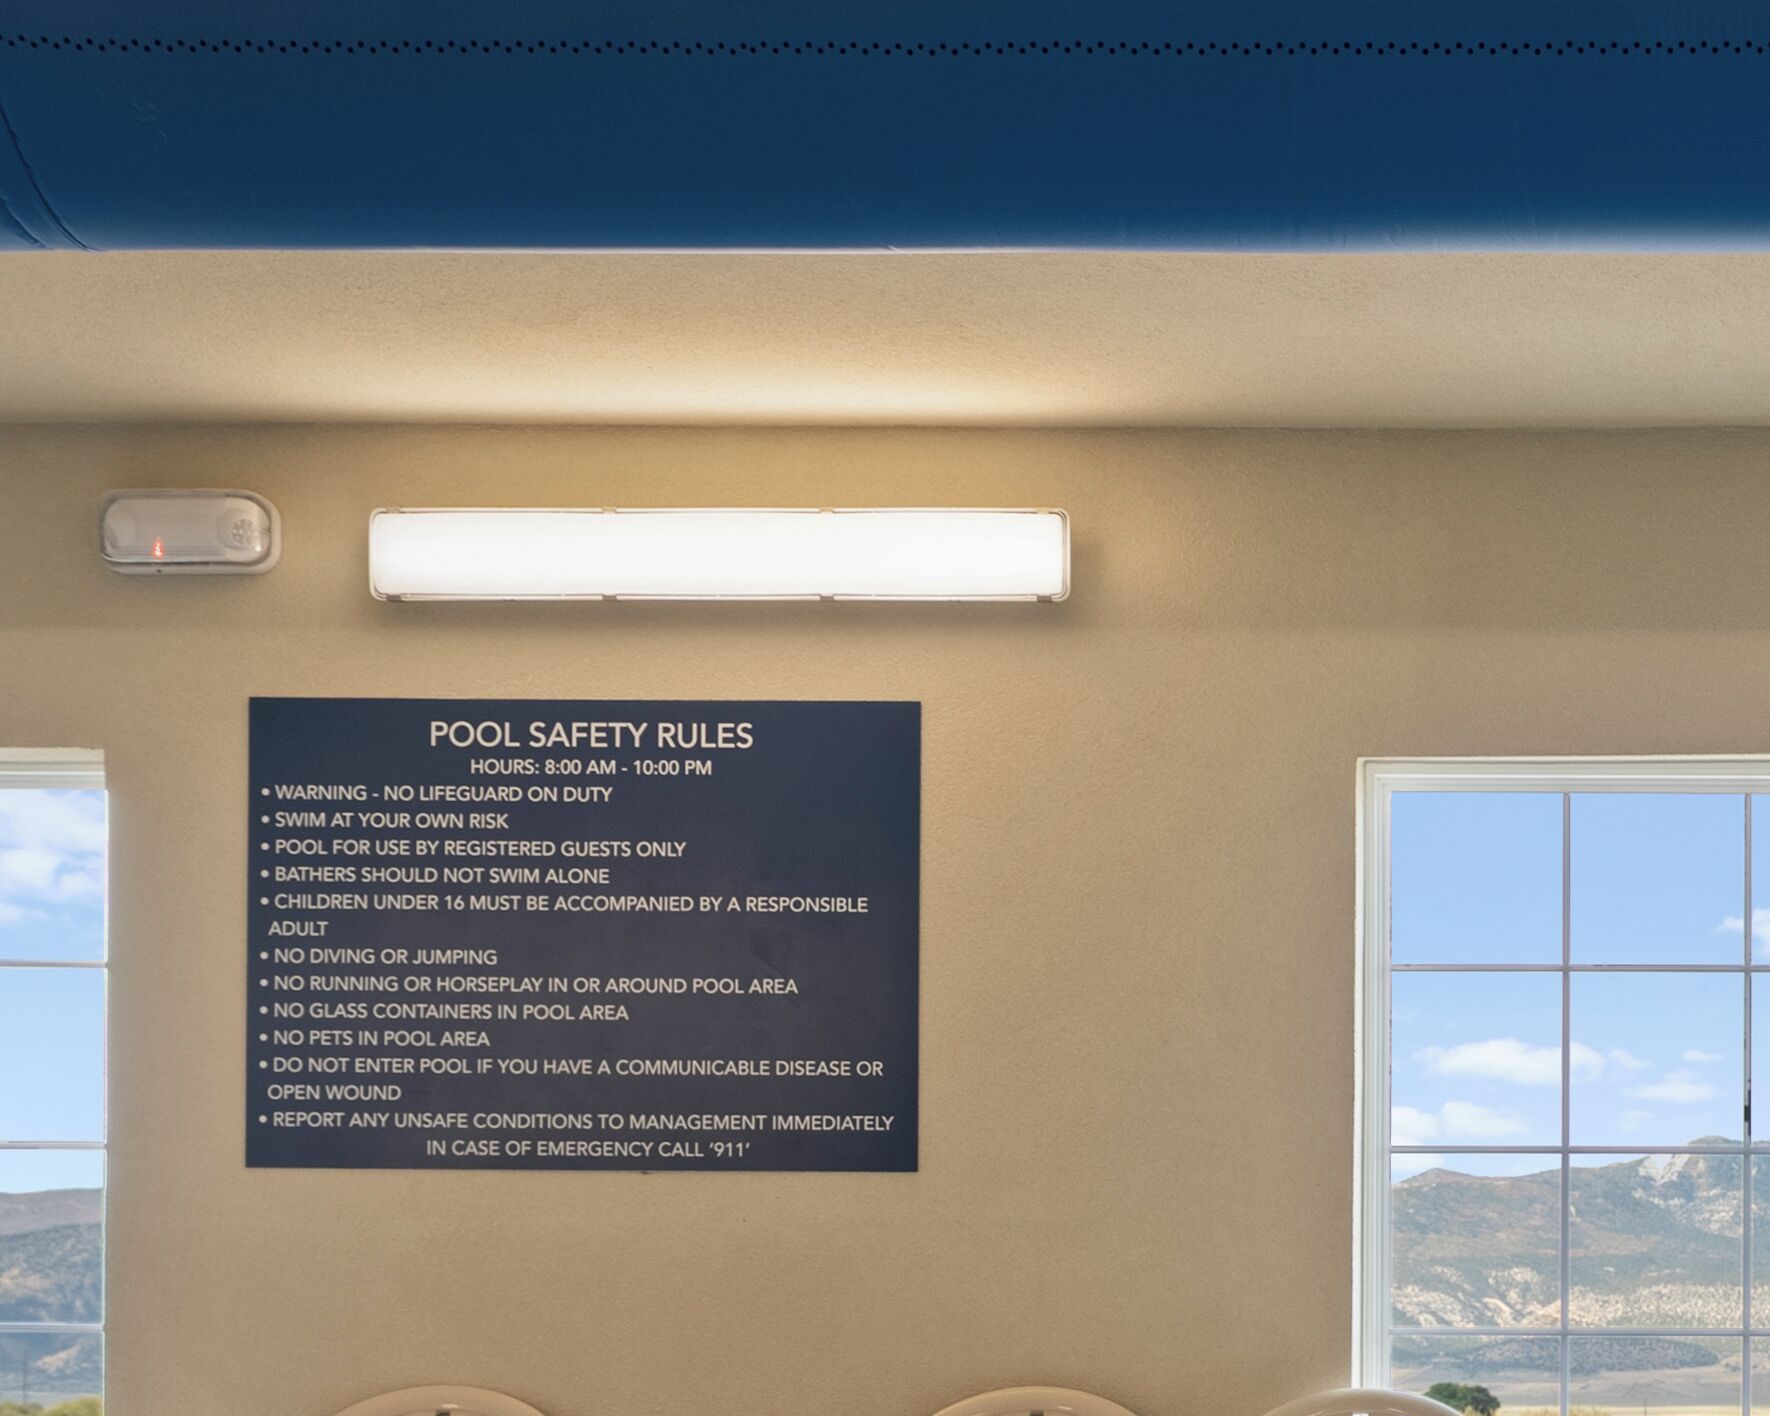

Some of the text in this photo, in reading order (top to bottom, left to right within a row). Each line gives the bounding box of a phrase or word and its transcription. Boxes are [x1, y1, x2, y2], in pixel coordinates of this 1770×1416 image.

[430, 720, 754, 749] POOL SAFETY RULES
[470, 758, 540, 775] HOURS:
[544, 758, 583, 775] 8:00
[585, 759, 617, 775] AM
[632, 759, 680, 776] 10:00
[684, 759, 713, 776] PM
[274, 784, 368, 801] WARNING
[383, 784, 415, 802] NO
[419, 785, 523, 802] LIFEGUARD
[527, 785, 558, 803] ON
[562, 786, 614, 803] DUTY
[274, 811, 510, 830] SWIM AT YOUR OWN RISK
[275, 838, 687, 858] POOL FOR USE BY REGISTERED GUESTS ONLY
[274, 865, 610, 884] BATHERS SHOULD NOT SWIM ALONE
[274, 893, 869, 913] CHILDREN UNDER 16 MUST BE ACCOMPANIED BY A RESPONSIBLE
[267, 920, 329, 937] ADULT
[274, 947, 498, 966] NO DIVING OR JUMPING
[274, 975, 799, 995] NO RUNNING OR HORSEPLAY IN OR AROUND POOL AREA
[273, 1002, 630, 1021] NO GLASS CONTAINERS IN POOL AREA
[273, 1029, 491, 1047] NO PETS IN POOL AREA
[273, 1056, 884, 1077] DO NOT ENTER POOL IF YOU HAVE A COMMUNICABLE DISEASE OR
[267, 1083, 402, 1101] OPEN WOUND
[273, 1111, 895, 1131] REPORT ANY UNSAFE CONDITIONS TO MANAGEMENT IMMEDIATELY
[426, 1139, 446, 1156] IN
[451, 1139, 501, 1156] CASE
[504, 1140, 532, 1157] OF
[537, 1140, 654, 1157] EMERGENCY
[658, 1141, 705, 1158] CALL
